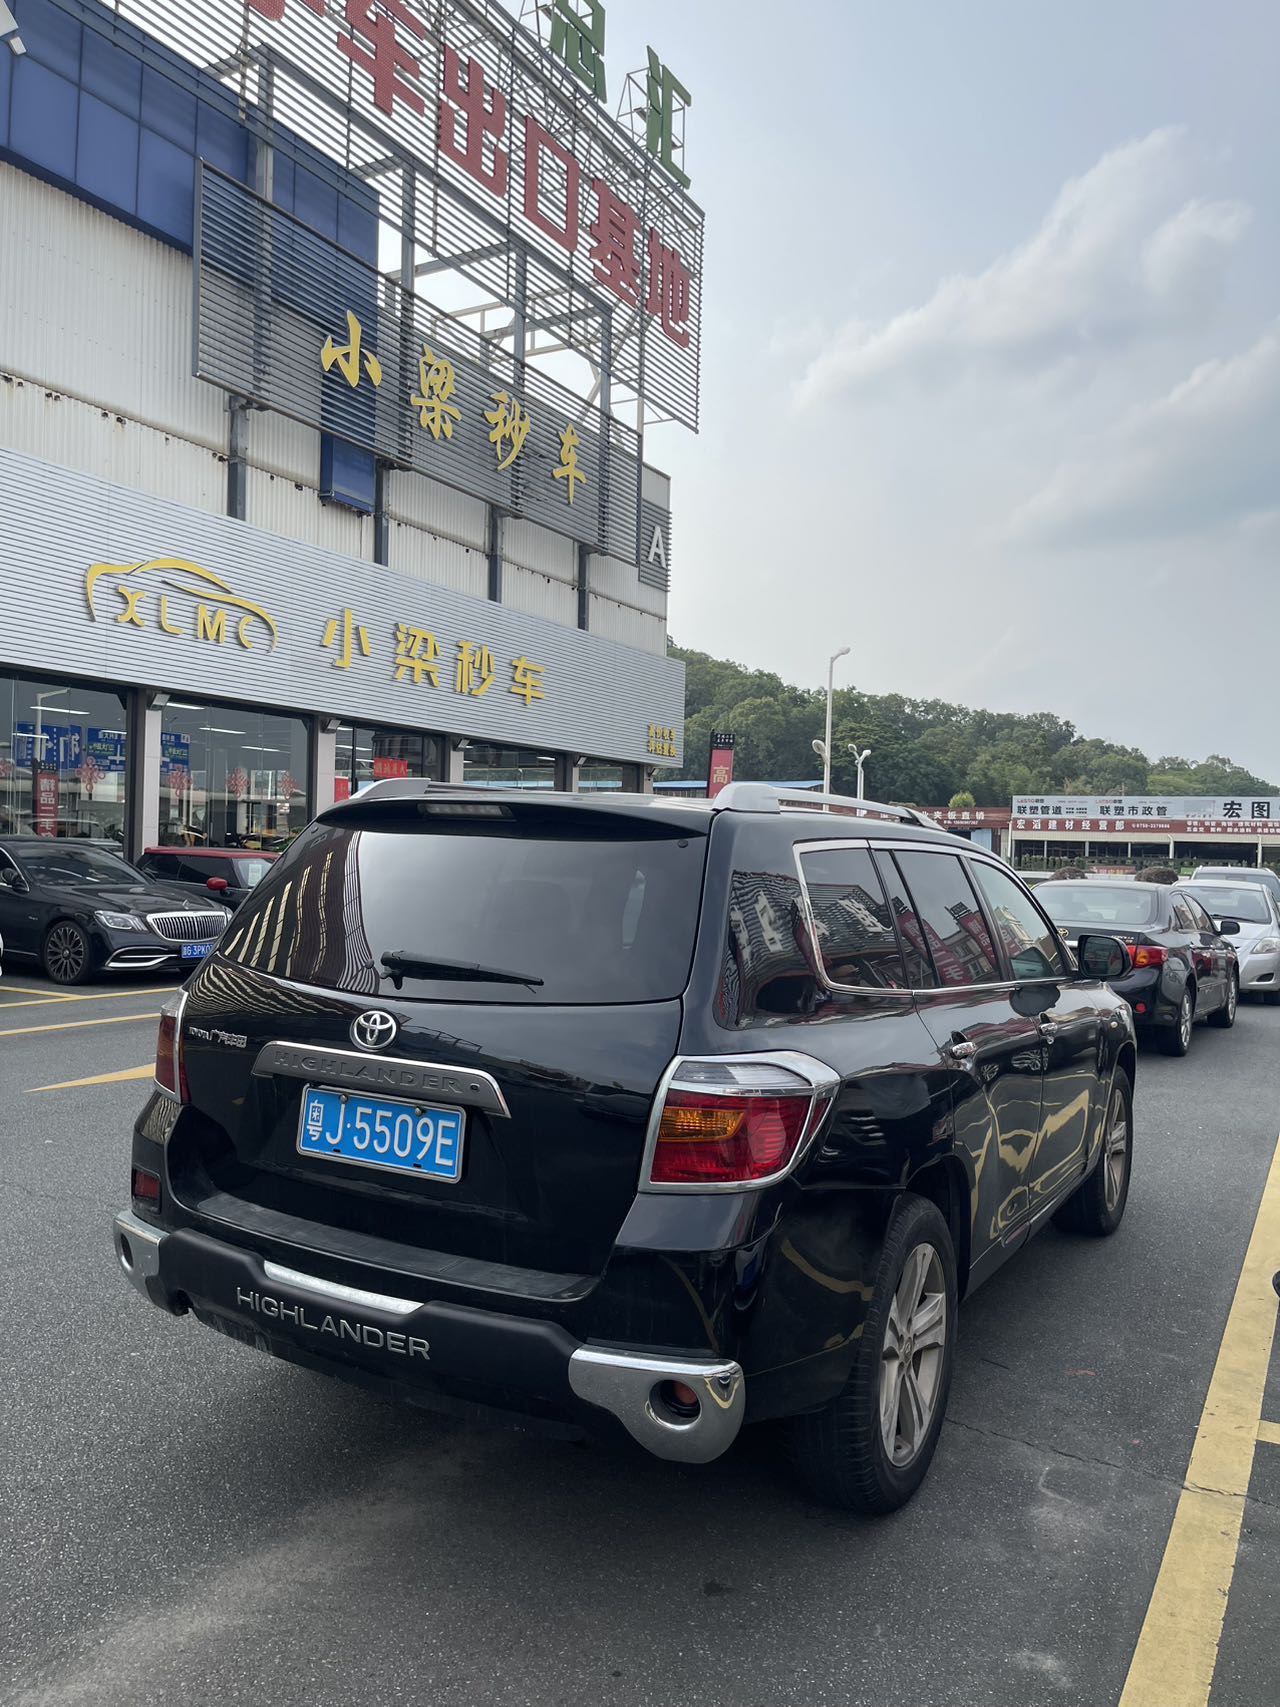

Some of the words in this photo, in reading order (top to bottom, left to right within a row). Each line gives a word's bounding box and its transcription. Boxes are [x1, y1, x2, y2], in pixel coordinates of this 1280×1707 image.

[247, 0, 690, 347] 车出口基地
[321, 310, 587, 504] 小梁秒车
[648, 525, 667, 567] A
[117, 586, 258, 650] XLMC
[320, 607, 547, 706] 小梁秒车
[1017, 805, 1063, 815] 联塑管道
[1099, 805, 1168, 816] 联塑市政管
[1222, 800, 1271, 819] 宏图
[274, 1051, 464, 1095] HIGHLANDER
[236, 1285, 431, 1361] HIGHLANDER
